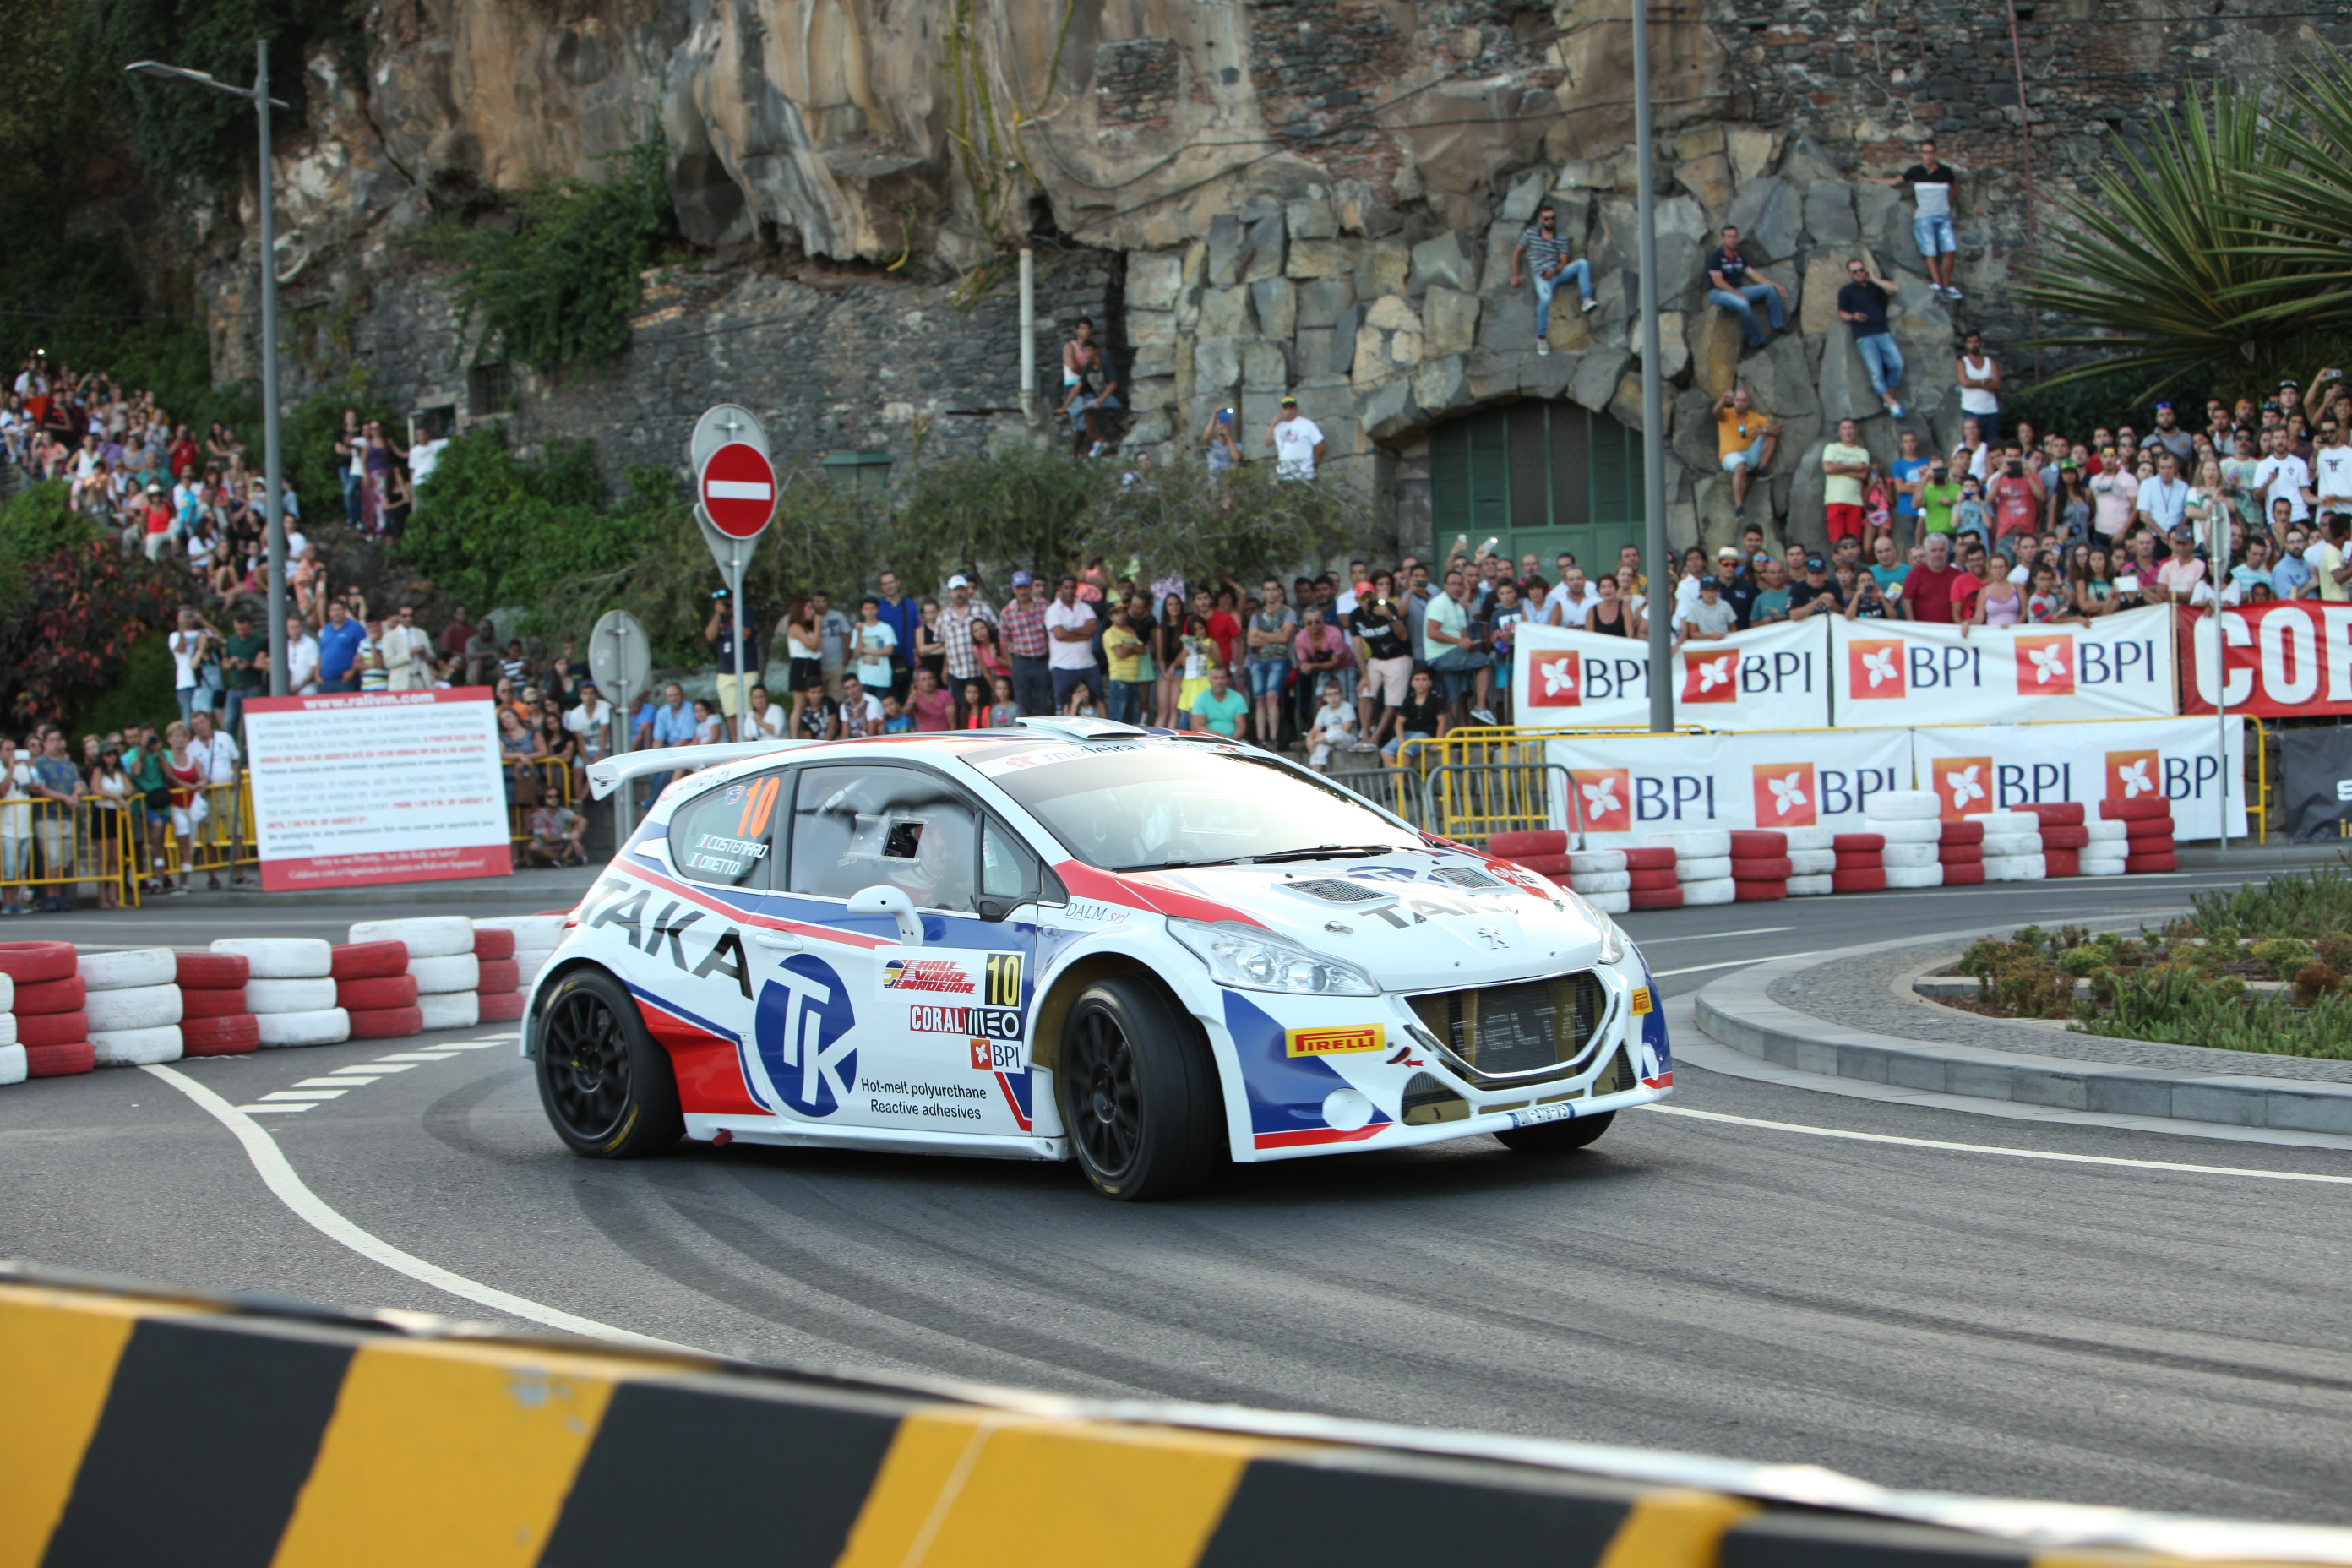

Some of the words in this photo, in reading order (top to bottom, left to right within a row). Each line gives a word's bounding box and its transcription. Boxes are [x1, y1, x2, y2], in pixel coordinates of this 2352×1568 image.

[1742, 651, 1811, 693] BPI
[1909, 646, 1981, 688] BPI
[2079, 640, 2154, 684] BPI
[1584, 659, 1650, 698] BPI
[1820, 767, 1896, 814] BPI
[1998, 763, 2071, 808] BPI
[2164, 754, 2230, 799] BPI
[736, 777, 781, 837] 10
[1635, 776, 1716, 821] BPI
[707, 836, 769, 858] COSTENARO
[698, 855, 741, 875] OMETTO
[1064, 902, 1108, 920] DALM
[1107, 912, 1130, 923] srl
[579, 877, 754, 1001] TAKA
[911, 960, 959, 972] RALI
[913, 971, 970, 982] VINHO
[988, 955, 1019, 1006] 10
[899, 980, 977, 994] MADEIRA
[912, 1006, 963, 1032] CORAL
[993, 1044, 1021, 1068] BPI
[1295, 1029, 1375, 1052] PIRELLI
[861, 1078, 909, 1095] Hot-melt
[912, 1082, 987, 1099] polyurethane
[871, 1098, 919, 1115] Reactive
[923, 1103, 982, 1119] adhesives
